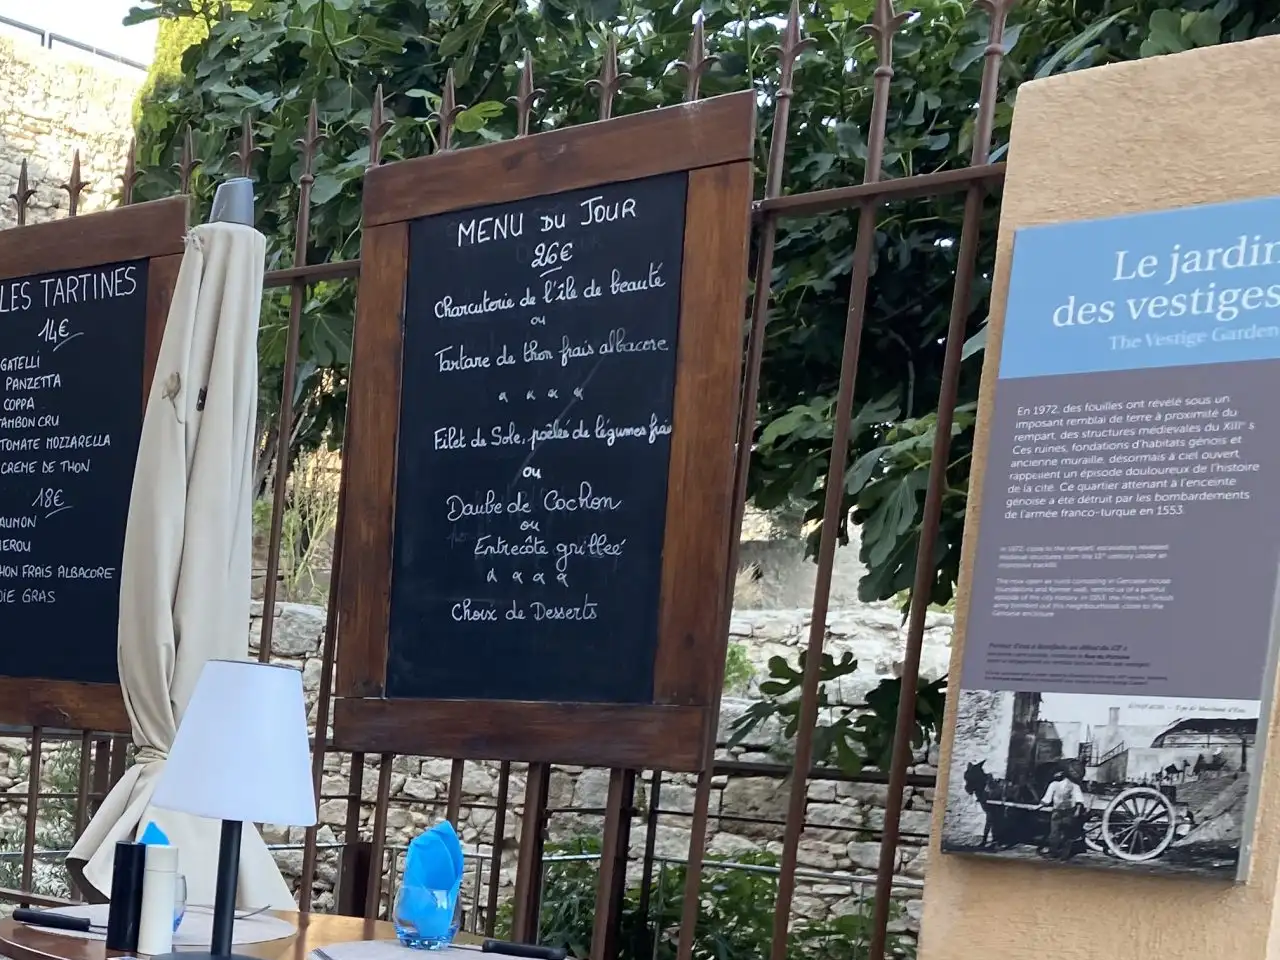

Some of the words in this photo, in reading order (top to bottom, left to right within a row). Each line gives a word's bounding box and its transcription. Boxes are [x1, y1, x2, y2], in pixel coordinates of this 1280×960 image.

[458, 213, 523, 247] MENU
[540, 214, 565, 232] DU
[580, 196, 636, 226] JOUR
[531, 242, 573, 269] 26€
[1113, 250, 1158, 281] Le
[1164, 234, 1280, 285] jardin
[0, 281, 32, 313] LES
[40, 266, 137, 307] TARTINES
[434, 290, 514, 319] Charcuterie
[520, 290, 536, 307] de
[584, 279, 602, 298] de
[610, 262, 666, 295] beauté
[1053, 295, 1115, 327] des
[1127, 282, 1280, 321] vestiges
[37, 318, 70, 343] 14€
[1109, 335, 1142, 350] The
[1145, 330, 1207, 348] Vestige
[1212, 324, 1280, 341] Garden
[434, 344, 491, 372] Tartare
[496, 345, 515, 366] de
[524, 340, 553, 362] thon
[559, 335, 594, 367] frais
[599, 327, 669, 354] albacore
[6, 373, 61, 392] PANZETTA
[4, 397, 35, 412] COPPA
[1018, 406, 1030, 416] En
[1063, 404, 1081, 413] des
[1085, 401, 1123, 411] fouilles
[1126, 400, 1144, 409] ont
[1185, 397, 1211, 406] sous
[1215, 396, 1230, 404] un
[38, 414, 60, 427] CRU
[1016, 418, 1063, 430] imposant
[1109, 414, 1123, 424] de
[1126, 413, 1152, 422] terre
[1222, 408, 1237, 417] du
[434, 426, 467, 450] Filet
[471, 427, 487, 448] de
[573, 420, 591, 440] de
[594, 414, 647, 446] légumes
[1060, 430, 1079, 440] des
[1082, 428, 1136, 438] structures
[1204, 422, 1220, 432] du
[0, 437, 40, 452] TOMATE
[46, 434, 111, 449] MOZZARELLA
[1013, 445, 1032, 454] Ces
[1072, 440, 1129, 452] fondations
[1230, 436, 1242, 444] et
[1, 460, 38, 474] CREME
[42, 460, 56, 473] DE
[60, 459, 90, 473] THON
[1010, 458, 1058, 468] ancienne
[1178, 451, 1198, 460] ciel
[523, 466, 542, 479] ou
[1010, 471, 1060, 482] rappellent
[1064, 470, 1078, 479] un
[1126, 466, 1189, 476] douloureux
[1193, 464, 1208, 474] de
[1008, 484, 1021, 494] de
[1024, 484, 1032, 492] la
[1060, 482, 1075, 492] Ce
[1077, 481, 1120, 492] quartier
[1122, 480, 1168, 490] attenant
[32, 488, 65, 508] 18€
[447, 490, 502, 522] Daube
[507, 492, 532, 514] de
[544, 481, 622, 512] Cochon
[1116, 494, 1134, 504] par
[1136, 493, 1151, 502] les
[1154, 490, 1250, 502] bombardements
[1005, 510, 1018, 519] de
[1061, 508, 1136, 520] franco-turque
[1140, 507, 1154, 516] en
[520, 520, 540, 532] ou
[474, 534, 549, 556] Entrecôte
[58, 565, 115, 579] ALBACORE
[22, 588, 56, 603] GRAS
[452, 598, 498, 622] Choix
[506, 600, 526, 620] de
[530, 593, 598, 621] Desserts
